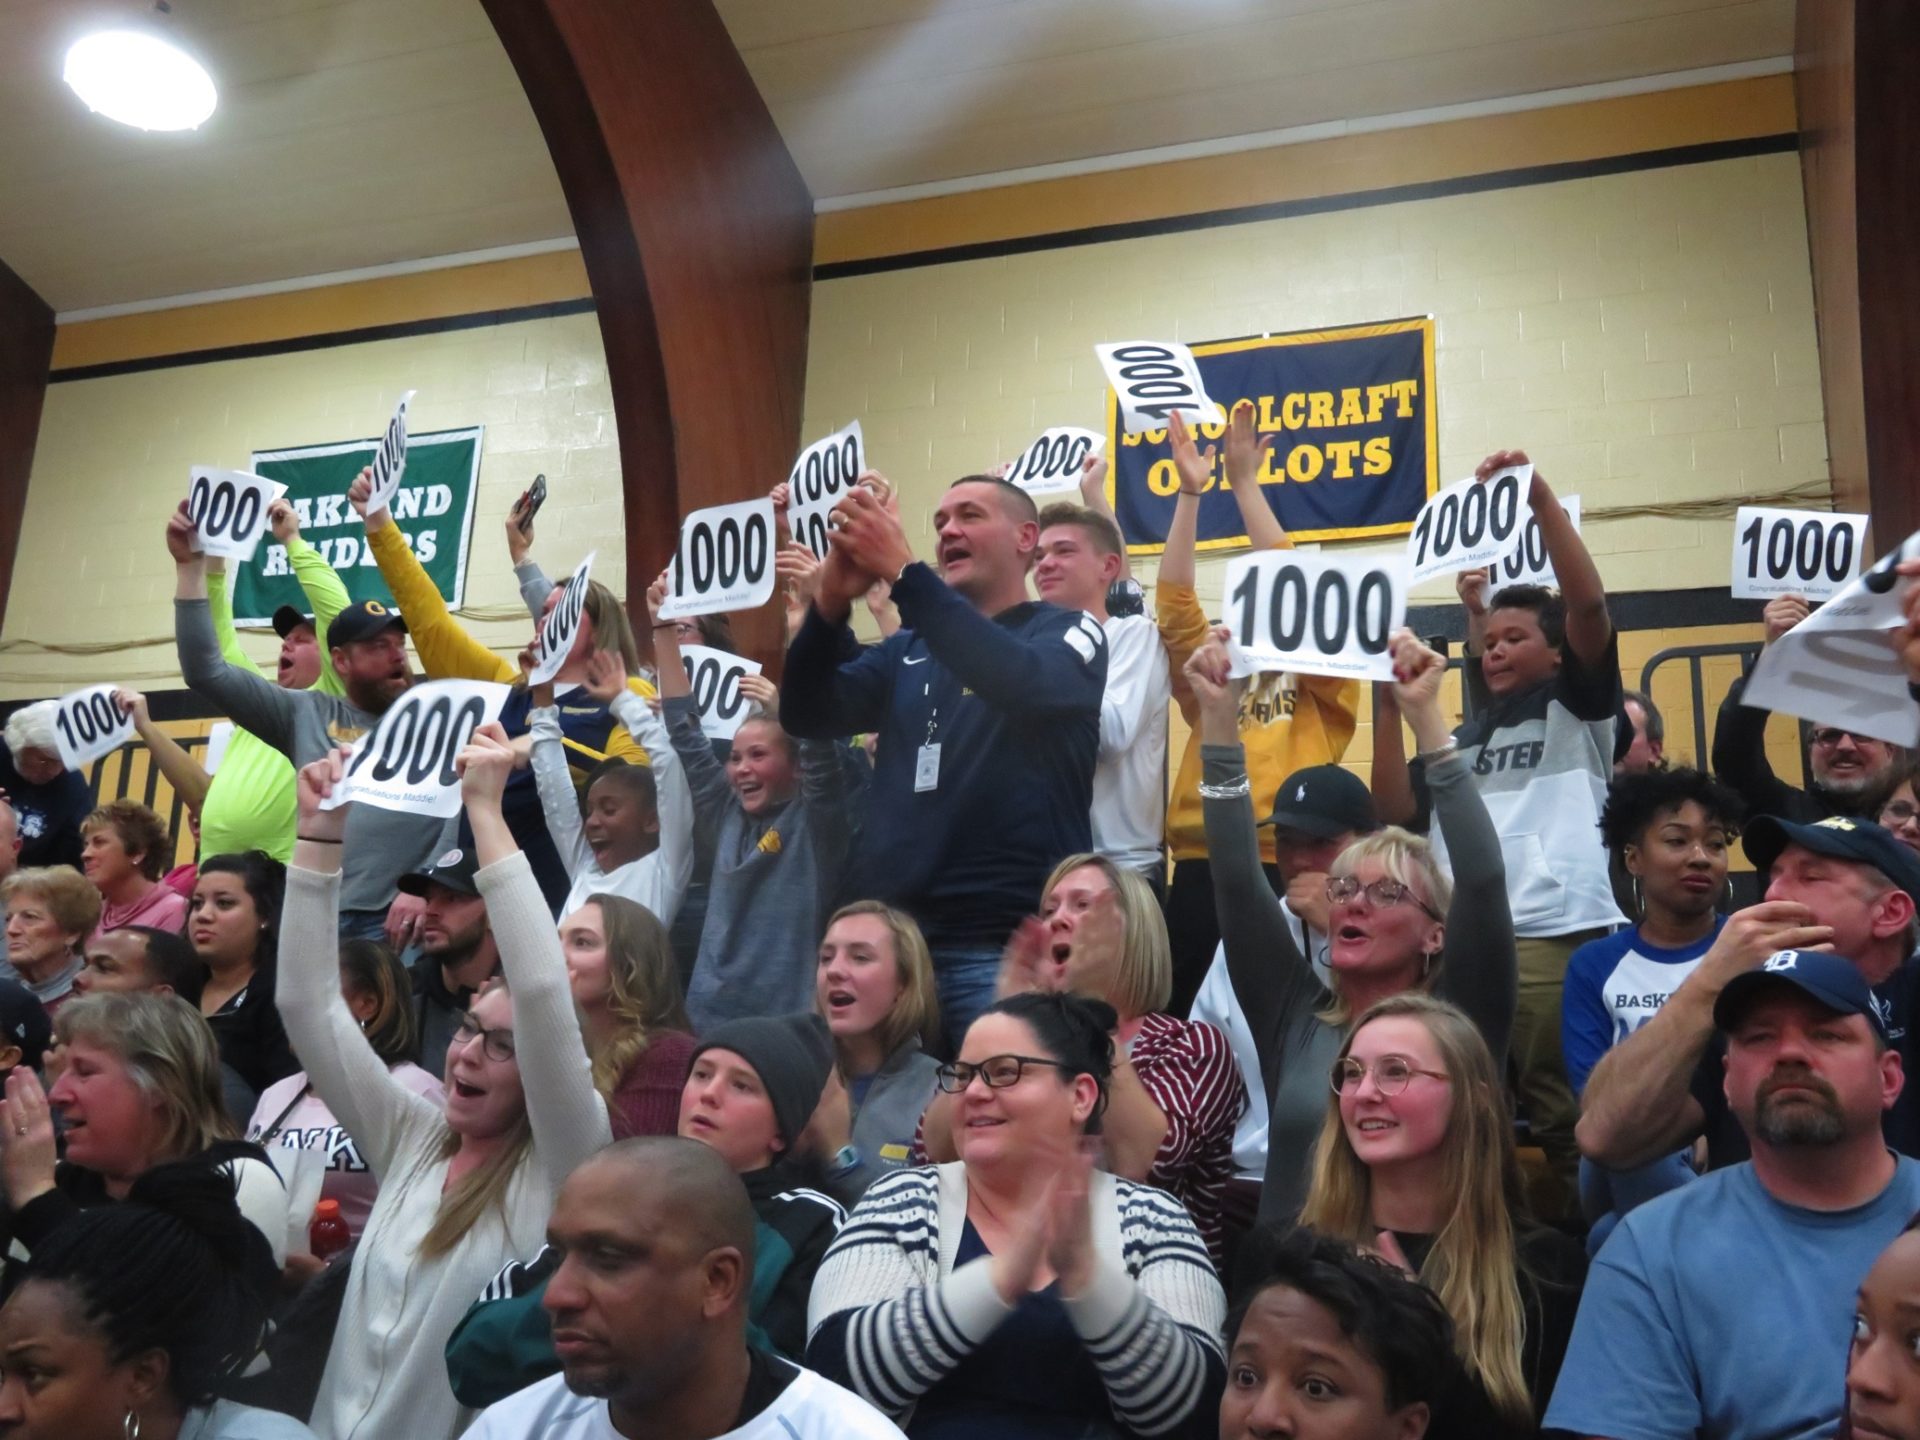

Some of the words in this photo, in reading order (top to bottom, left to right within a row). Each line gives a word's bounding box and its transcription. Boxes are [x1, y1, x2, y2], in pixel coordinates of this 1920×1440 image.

[1111, 346, 1200, 420] 1000
[794, 434, 859, 506] 1000
[674, 512, 768, 598] 1000
[1415, 475, 1519, 567] 1000
[1742, 516, 1854, 583] 1000
[1232, 564, 1392, 656] 1000
[1615, 993, 1675, 1009] BASK
